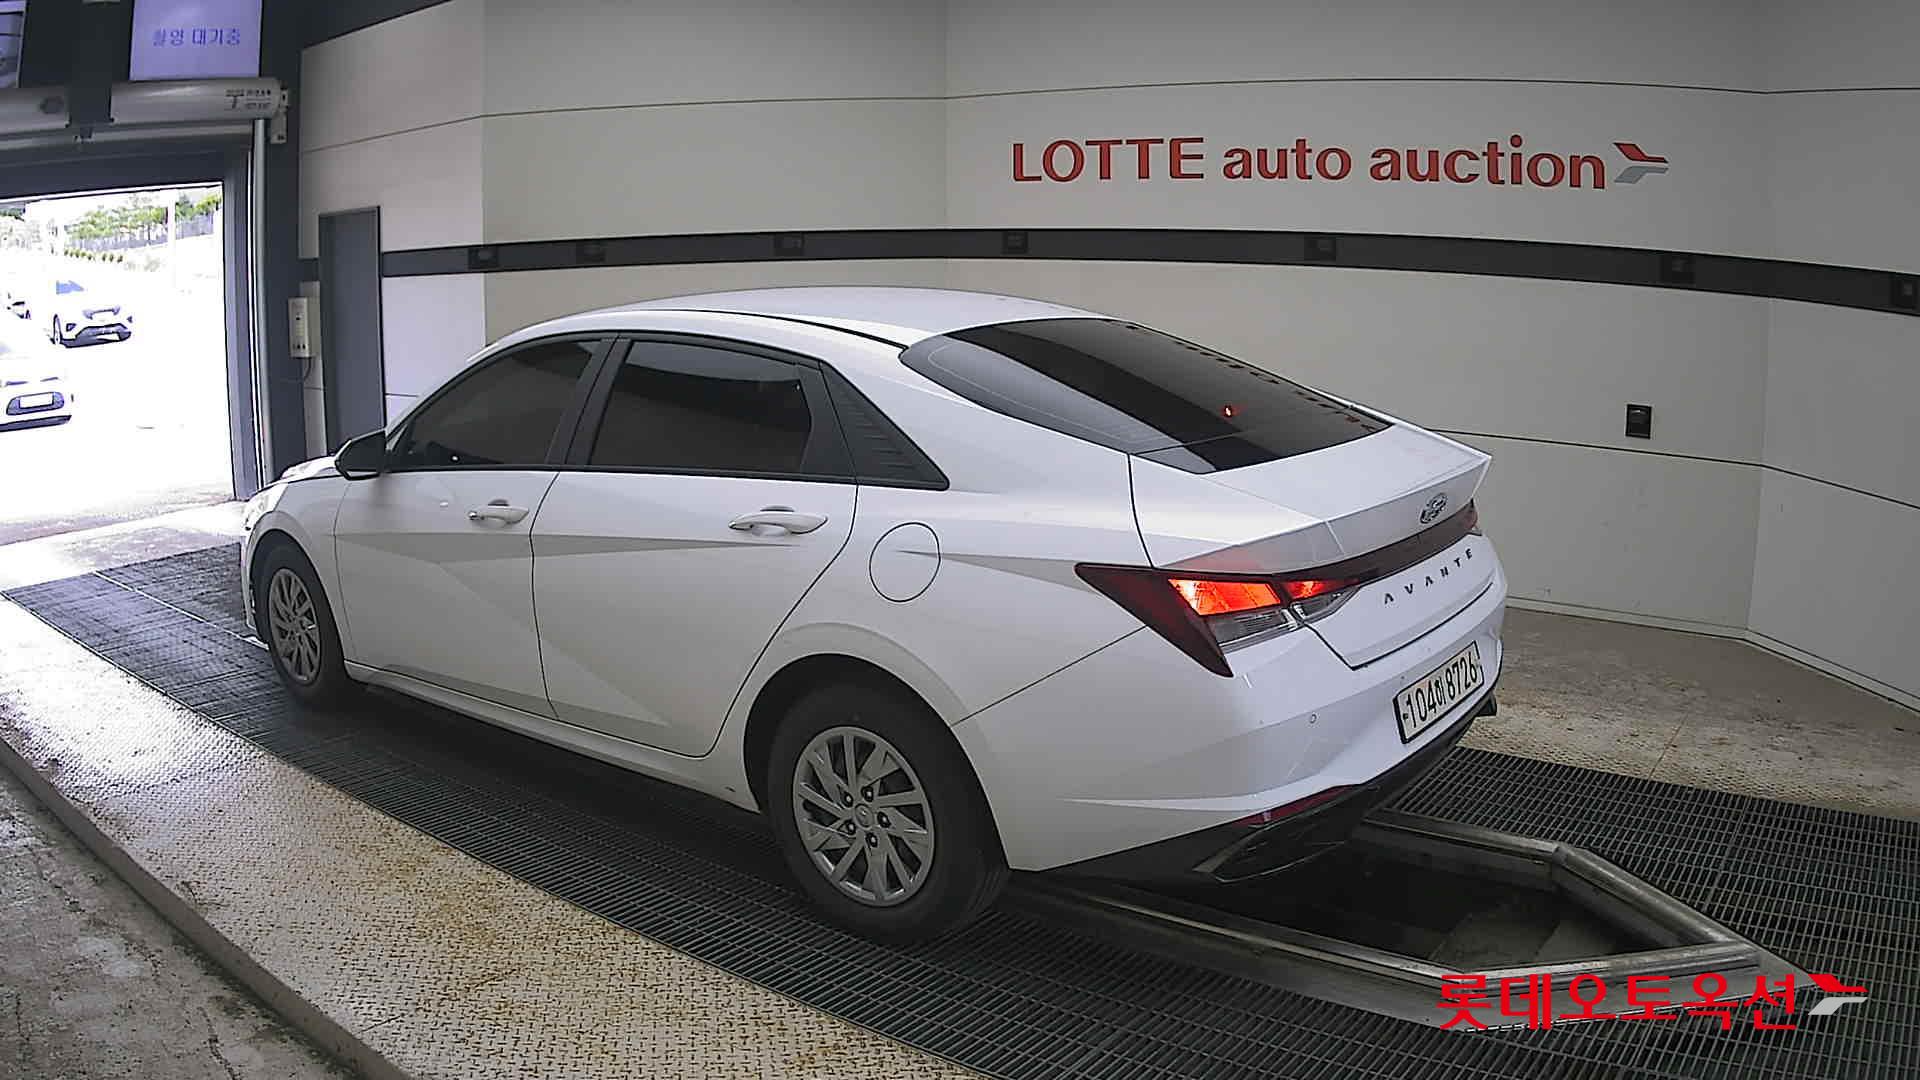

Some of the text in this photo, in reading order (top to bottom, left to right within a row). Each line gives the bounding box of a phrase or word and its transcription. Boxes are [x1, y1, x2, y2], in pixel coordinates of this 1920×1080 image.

[1013, 134, 1607, 190] LOTTE auto auction
[1384, 548, 1473, 605] AVANTE
